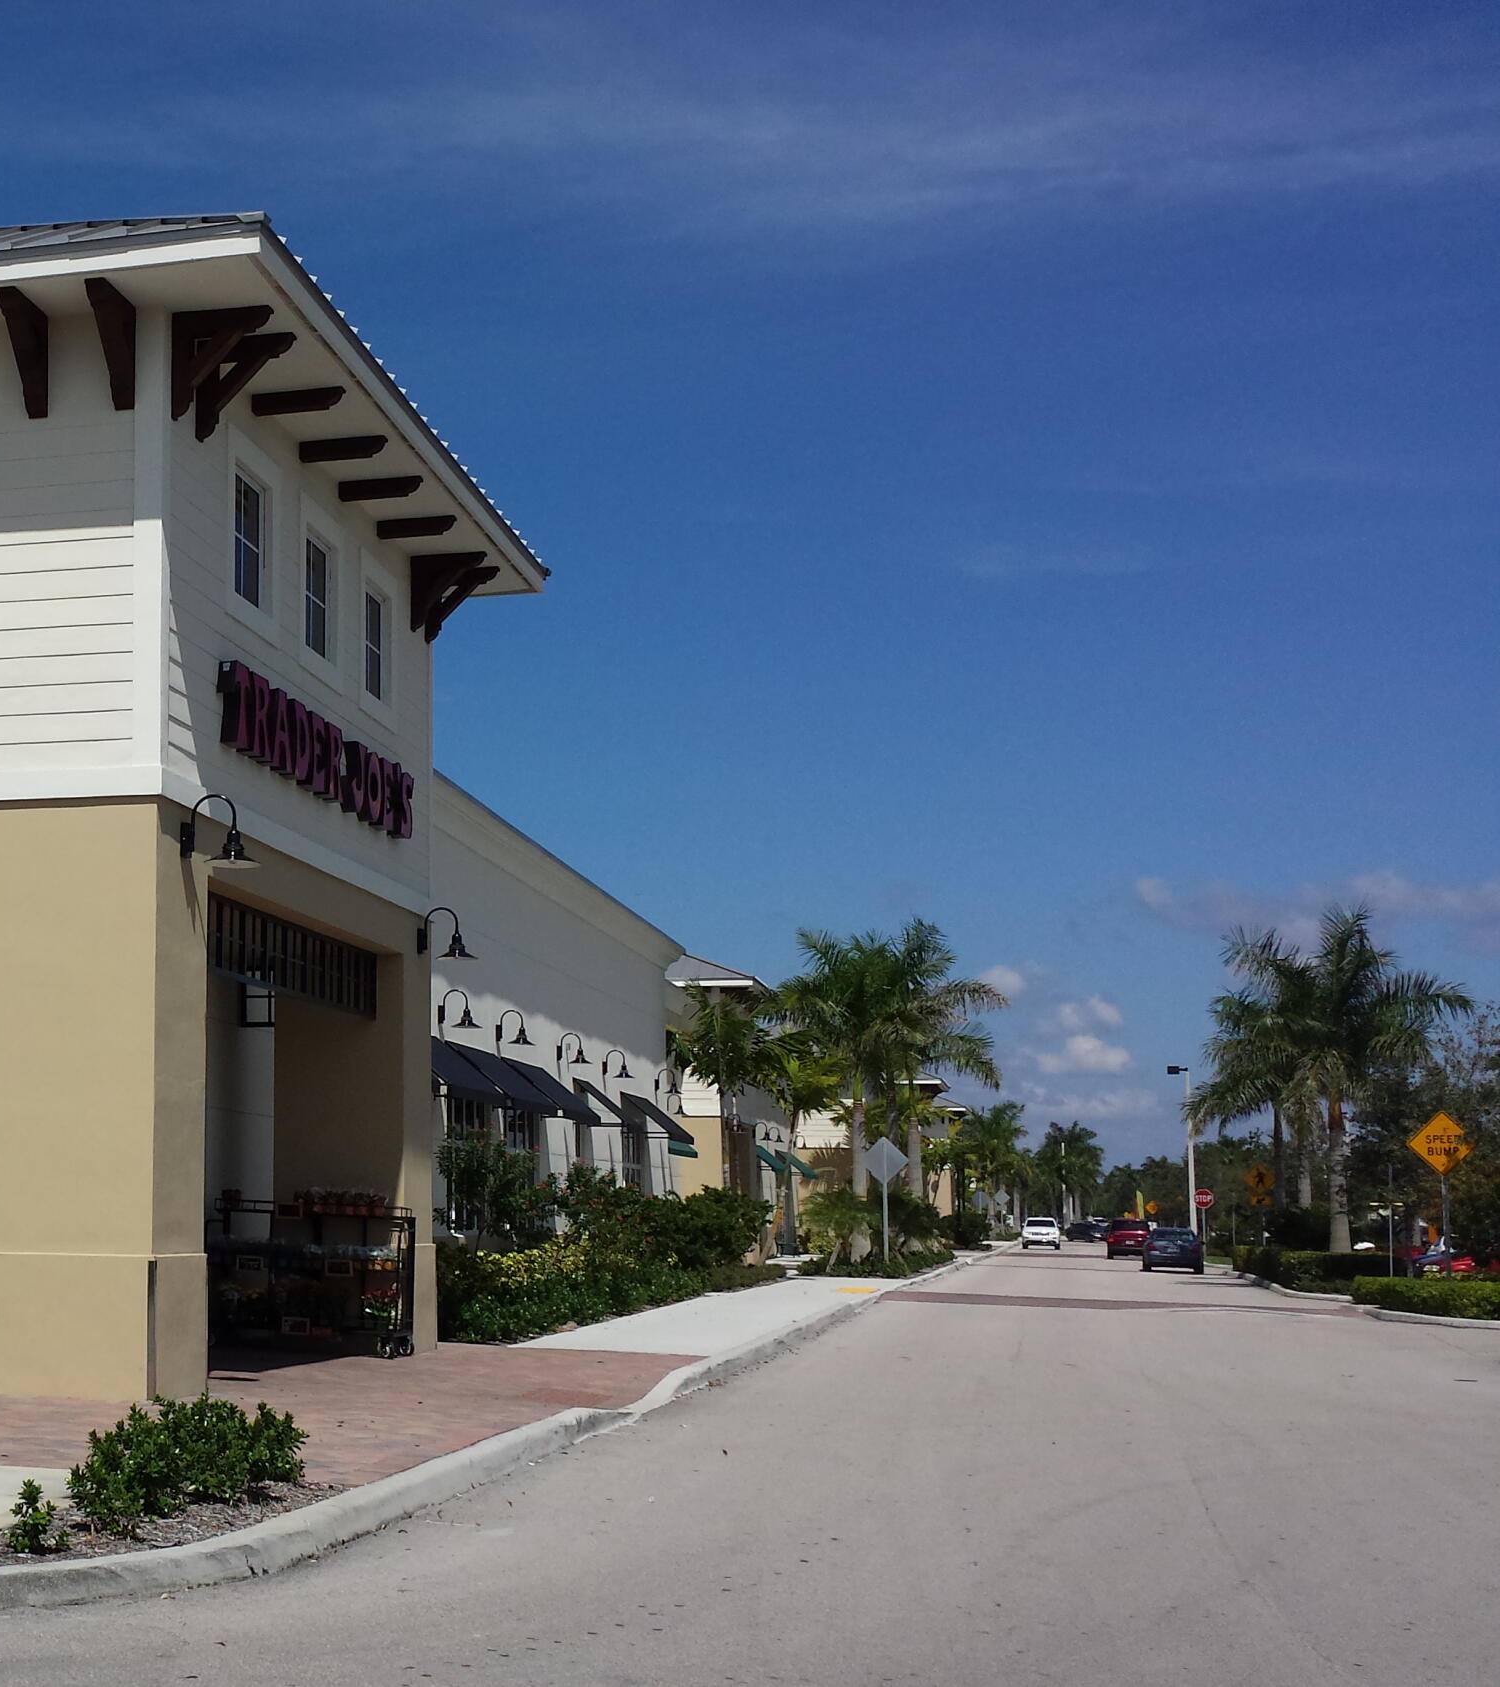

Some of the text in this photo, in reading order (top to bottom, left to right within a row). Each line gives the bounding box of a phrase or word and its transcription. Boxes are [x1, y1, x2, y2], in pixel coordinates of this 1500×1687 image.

[217, 660, 345, 808] TRADER
[1427, 1146, 1460, 1156] BUMP
[1195, 1194, 1212, 1203] STOP
